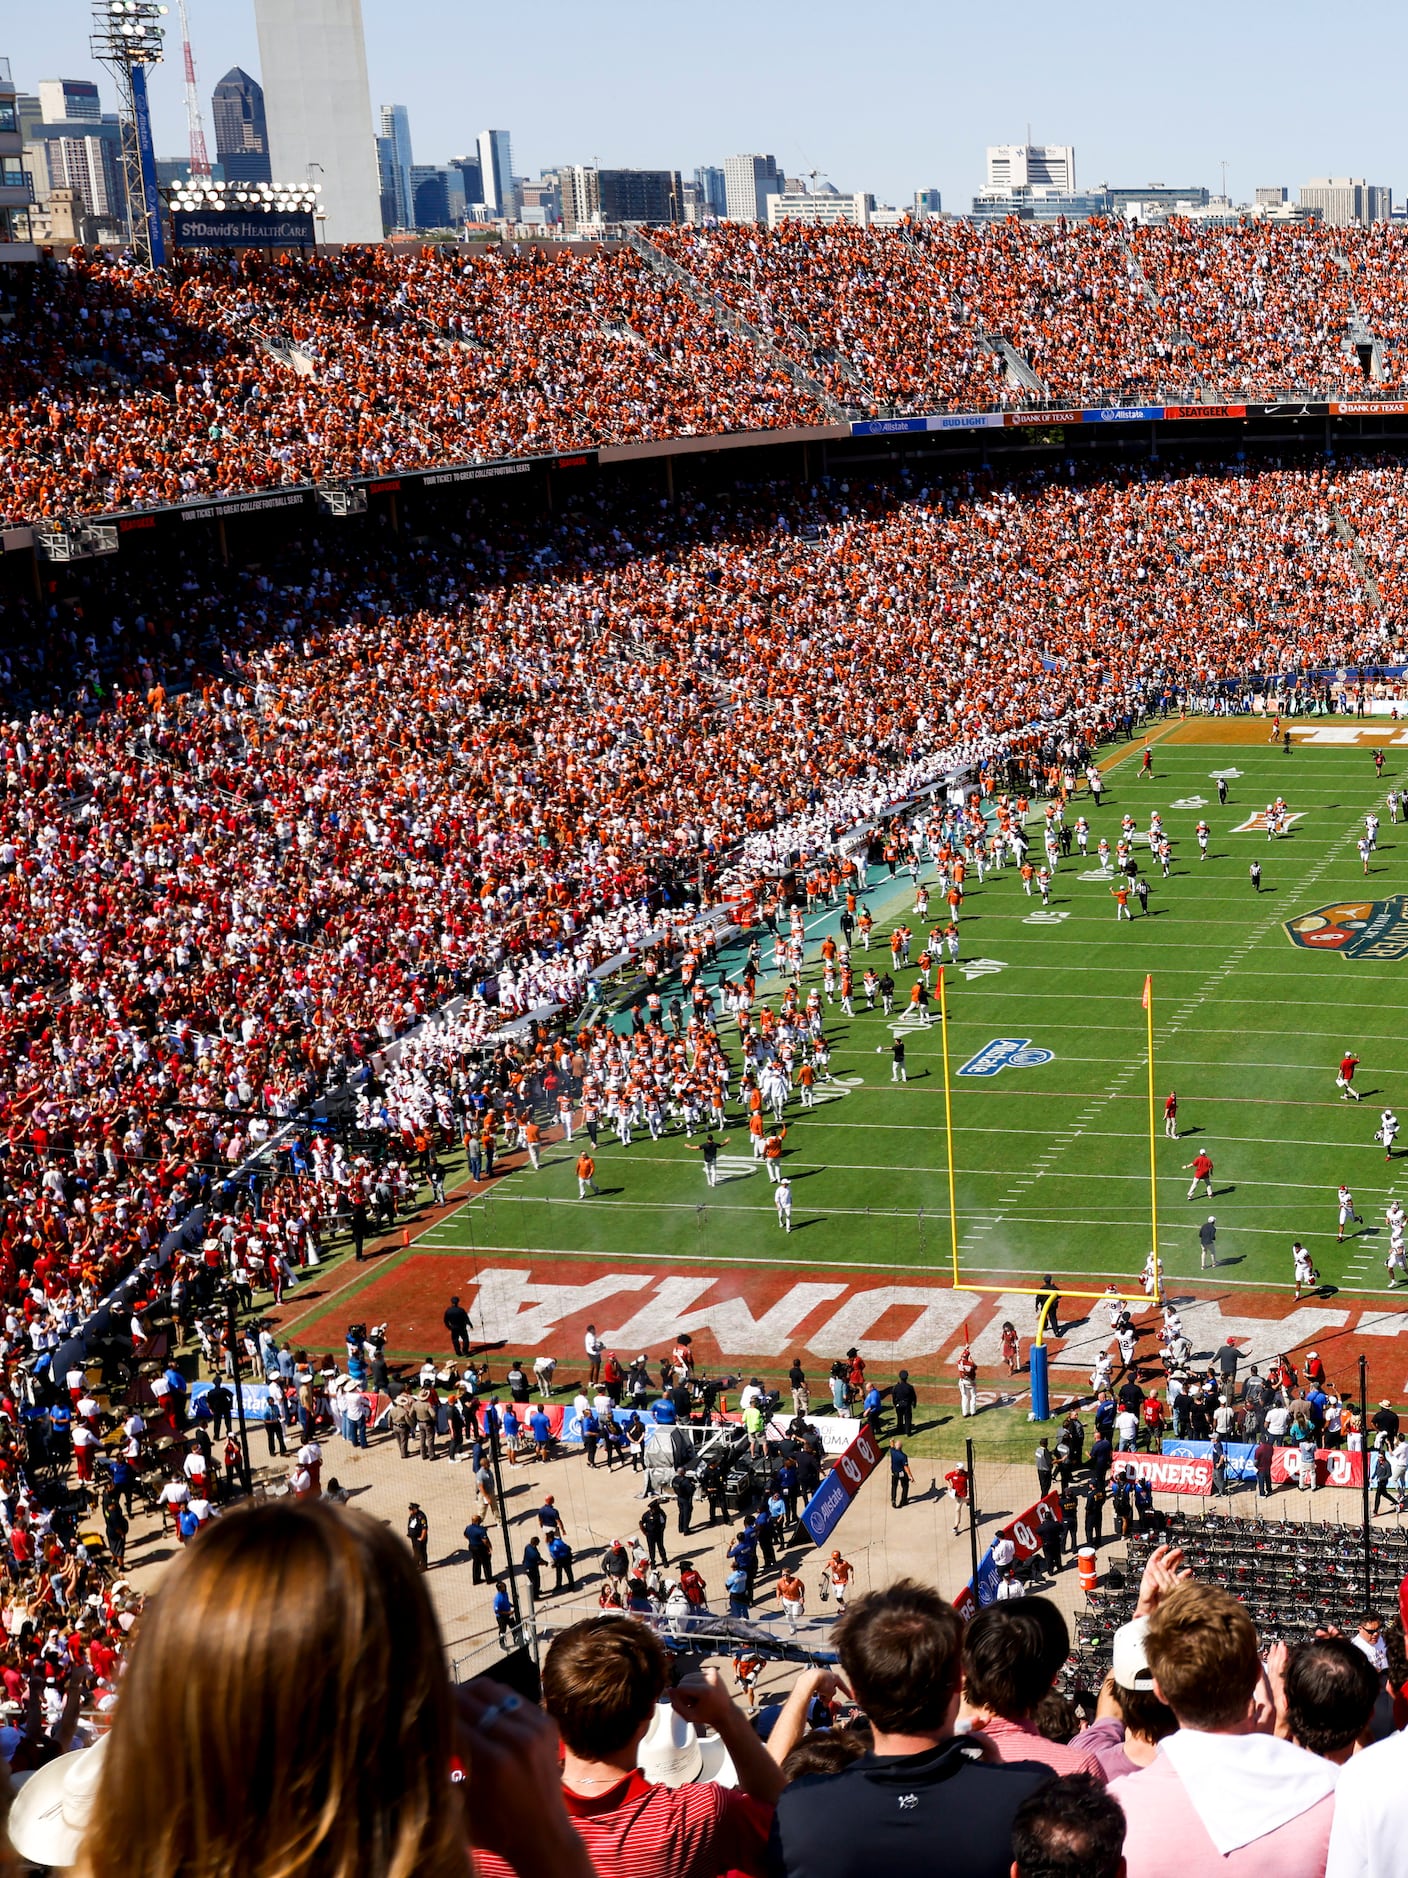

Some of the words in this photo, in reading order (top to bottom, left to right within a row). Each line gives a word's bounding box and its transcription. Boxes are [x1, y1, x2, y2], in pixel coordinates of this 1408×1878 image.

[1115, 410, 1144, 420] Allstate
[1179, 406, 1229, 417] SEATGEEK
[1348, 404, 1368, 412] BANK
[1370, 404, 1378, 412] OF
[1379, 403, 1404, 412] TEXAS
[882, 421, 908, 431] Allstate
[942, 418, 959, 427] BUD
[960, 417, 986, 426] LIGHT
[1020, 414, 1040, 423] BANK
[1052, 412, 1074, 421] TEXAS
[181, 511, 195, 521] YOUR
[196, 508, 214, 519] TICKET
[223, 504, 240, 515] GREAT
[262, 497, 288, 510] FOOTBALL
[288, 494, 303, 506] SEATS
[1360, 913, 1392, 939] RIVALRY
[966, 1040, 1021, 1074] Allstate
[1114, 1459, 1209, 1487] SOONERS
[1328, 1451, 1351, 1484] OU
[820, 1487, 844, 1522] Allstate
